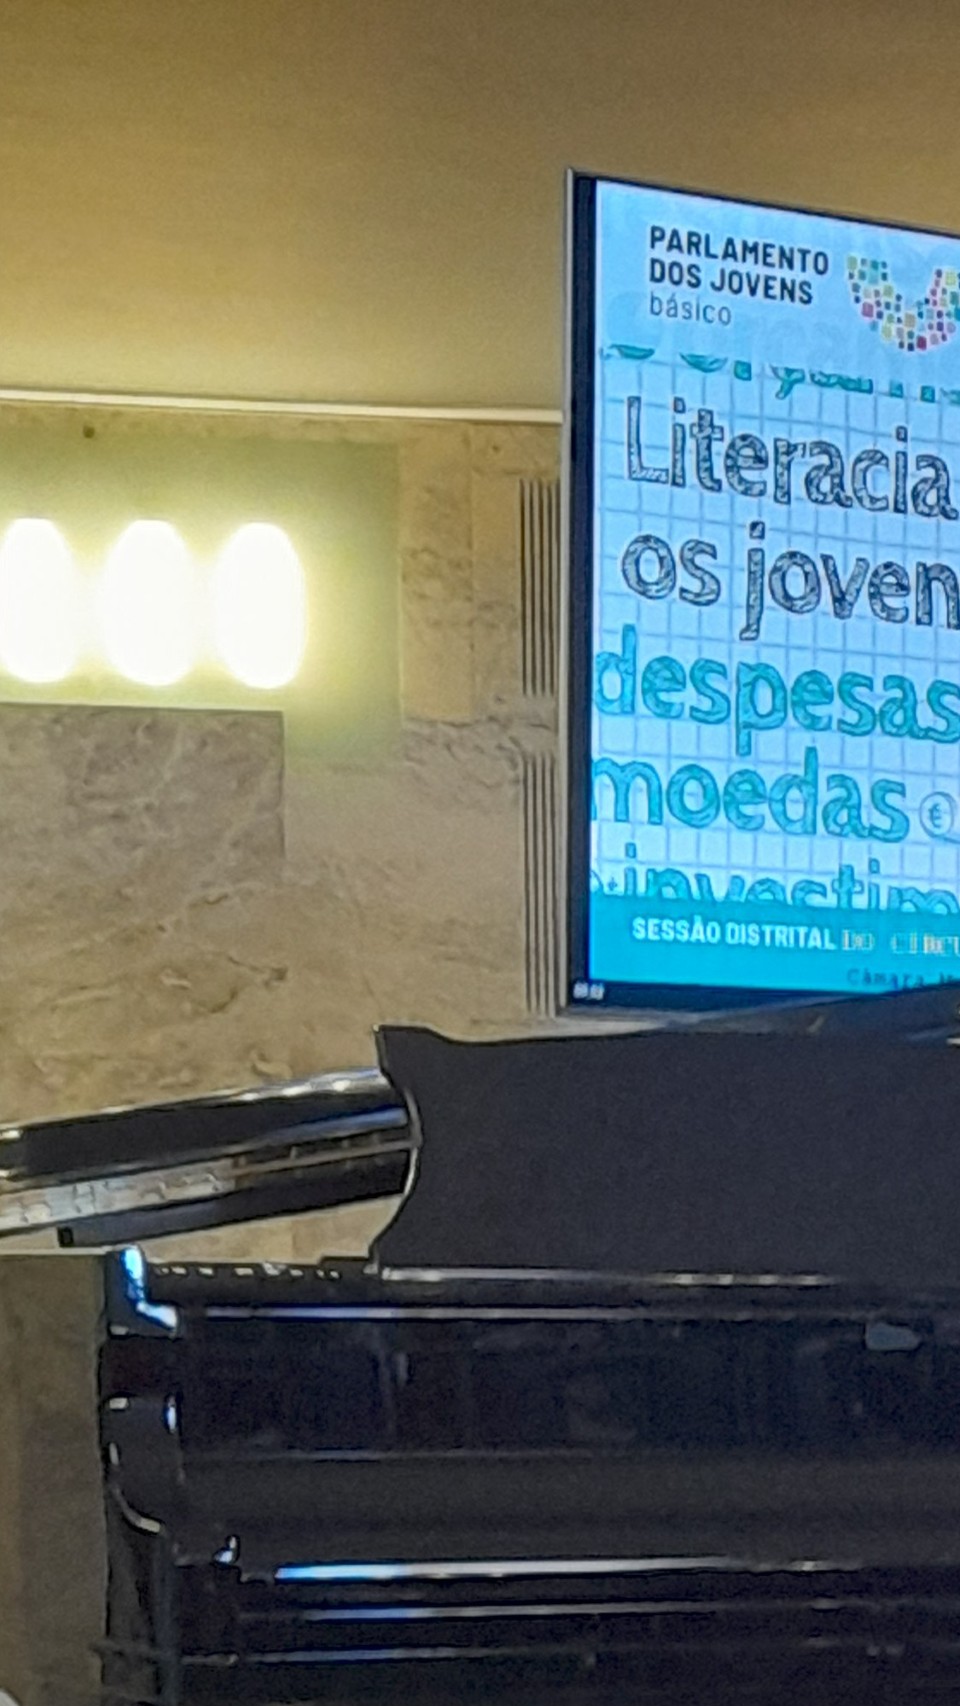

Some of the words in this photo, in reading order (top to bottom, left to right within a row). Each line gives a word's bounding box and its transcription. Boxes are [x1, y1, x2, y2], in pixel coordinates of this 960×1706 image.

[649, 225, 829, 276] PARLAMENTO
[649, 257, 702, 290] DOS
[710, 268, 814, 305] JOVENS
[649, 293, 732, 326] básico
[626, 396, 959, 521] Literacia
[621, 533, 722, 607] os
[590, 746, 910, 843] moedas
[632, 914, 721, 945] SESSÃO
[724, 920, 837, 952] DISTRITAL
